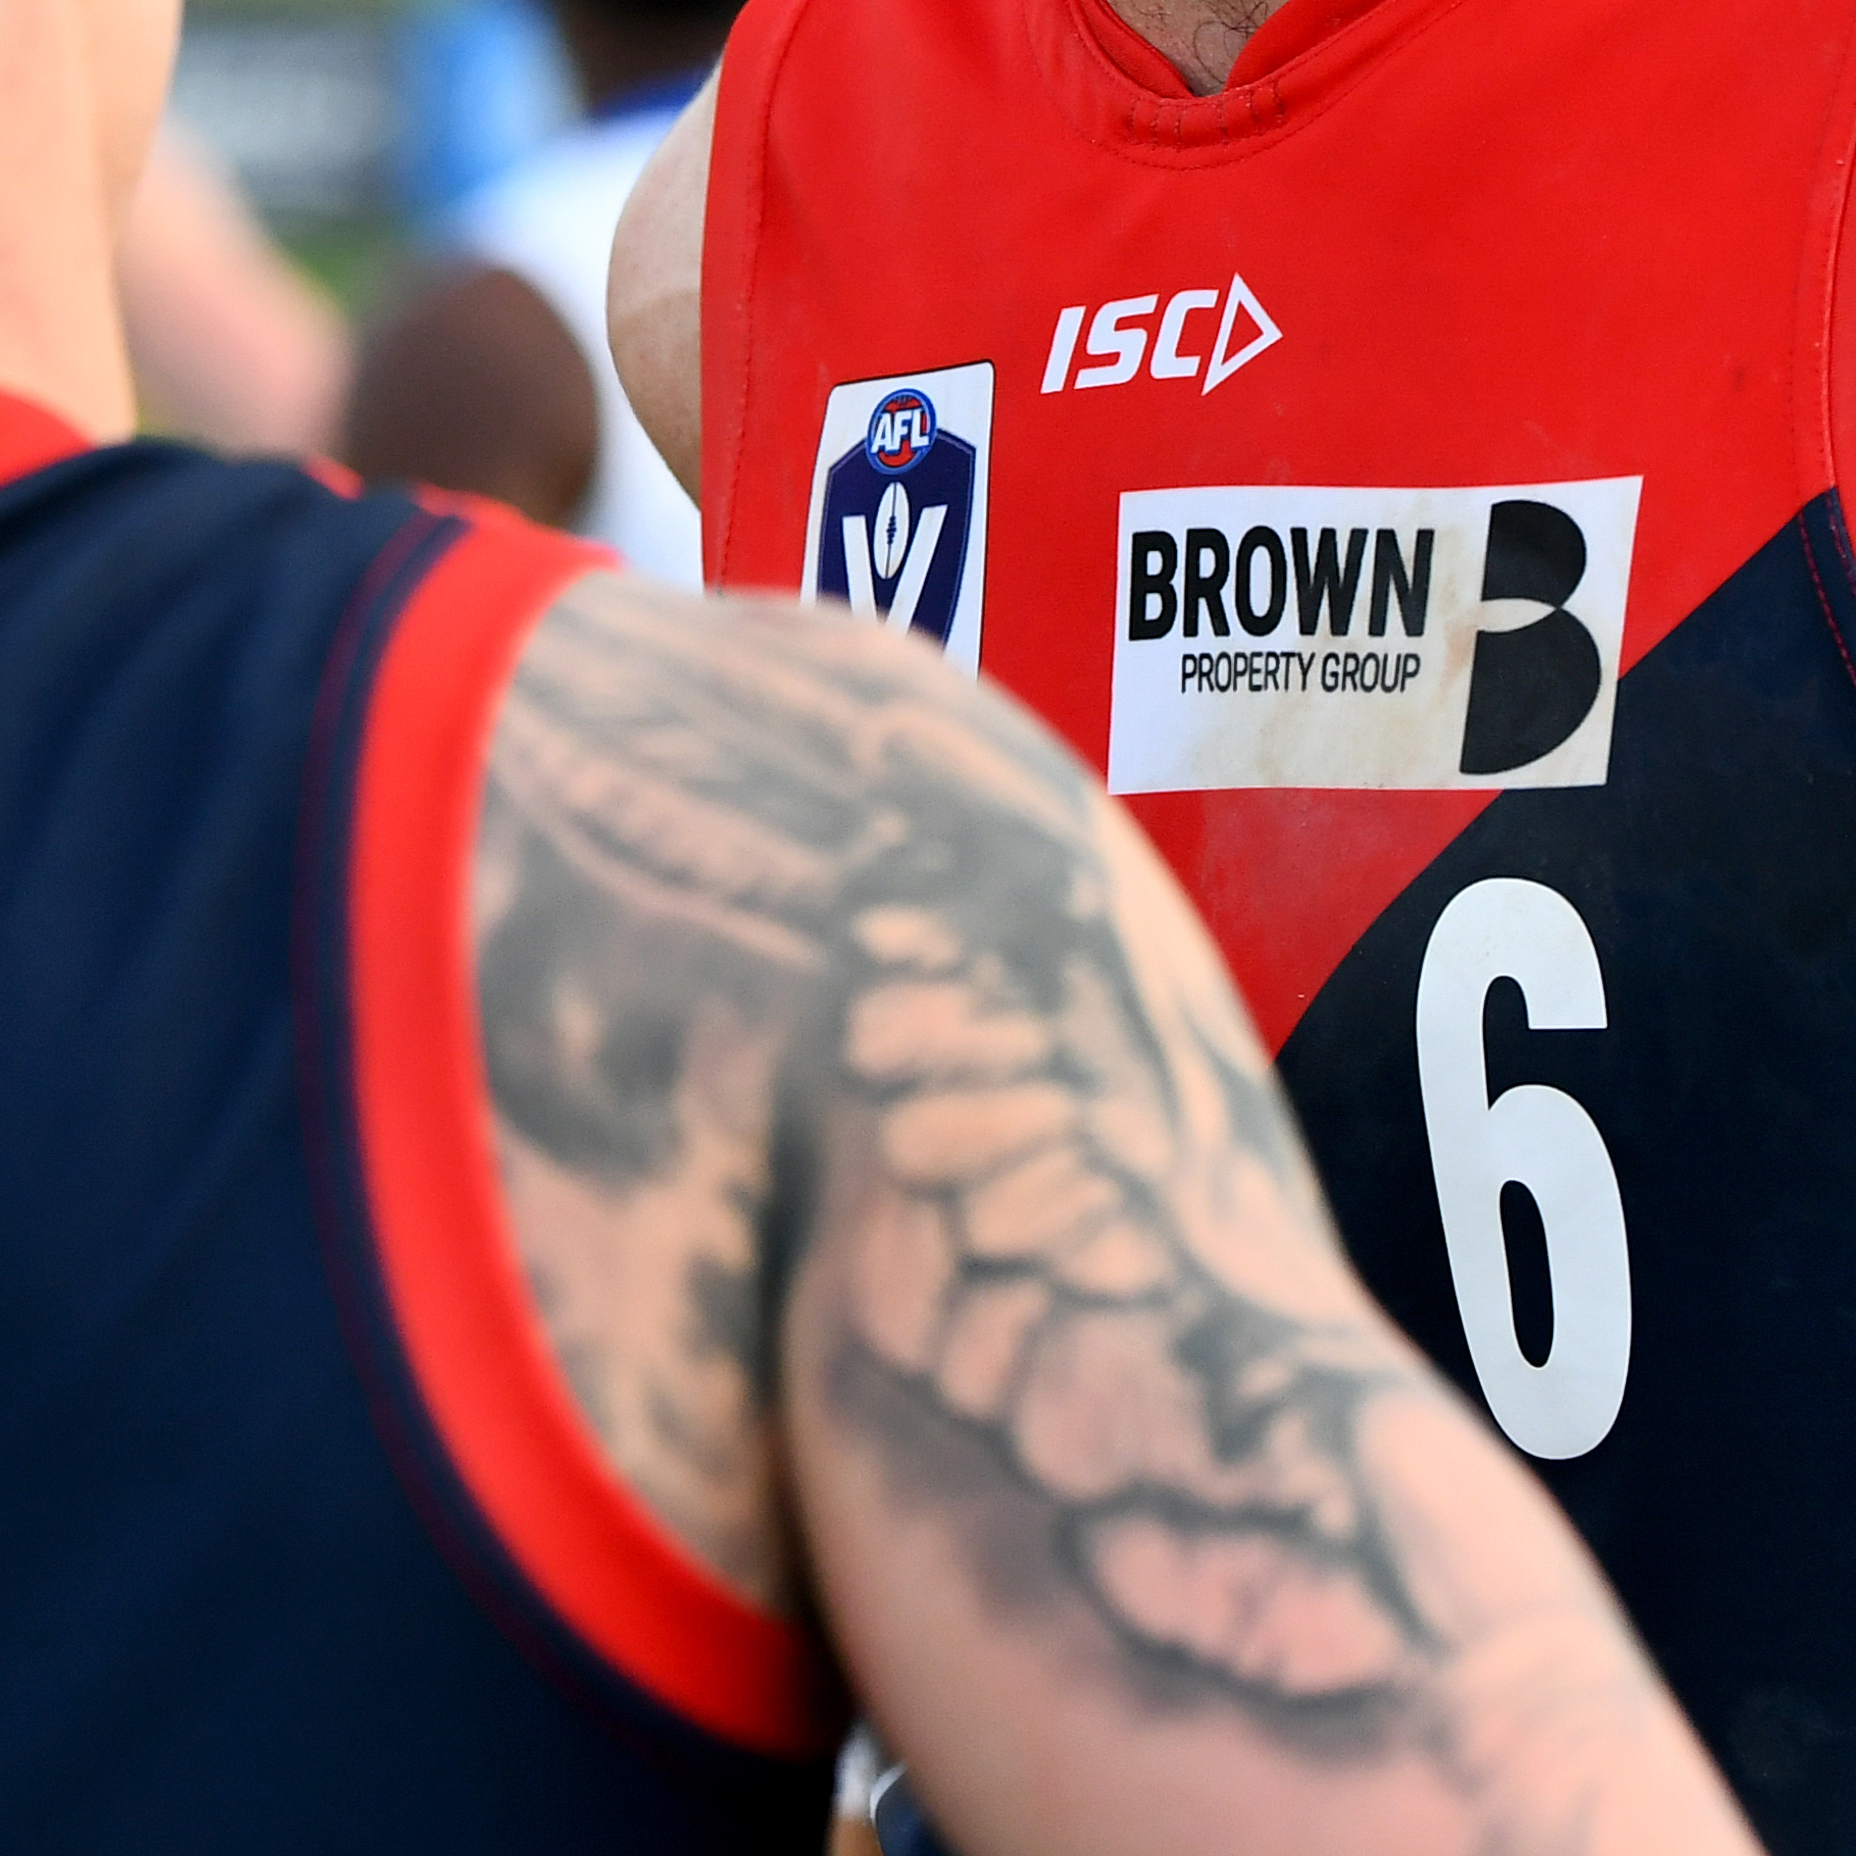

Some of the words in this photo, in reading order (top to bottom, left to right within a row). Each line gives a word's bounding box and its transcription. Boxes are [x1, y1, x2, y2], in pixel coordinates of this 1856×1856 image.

[1040, 289, 1219, 394] ISC
[870, 407, 930, 454] AFL
[1128, 525, 1436, 641] BROWN
[1180, 651, 1316, 694] PROPERTY
[1321, 651, 1422, 694] GROUP
[1416, 877, 1632, 1461] 6
